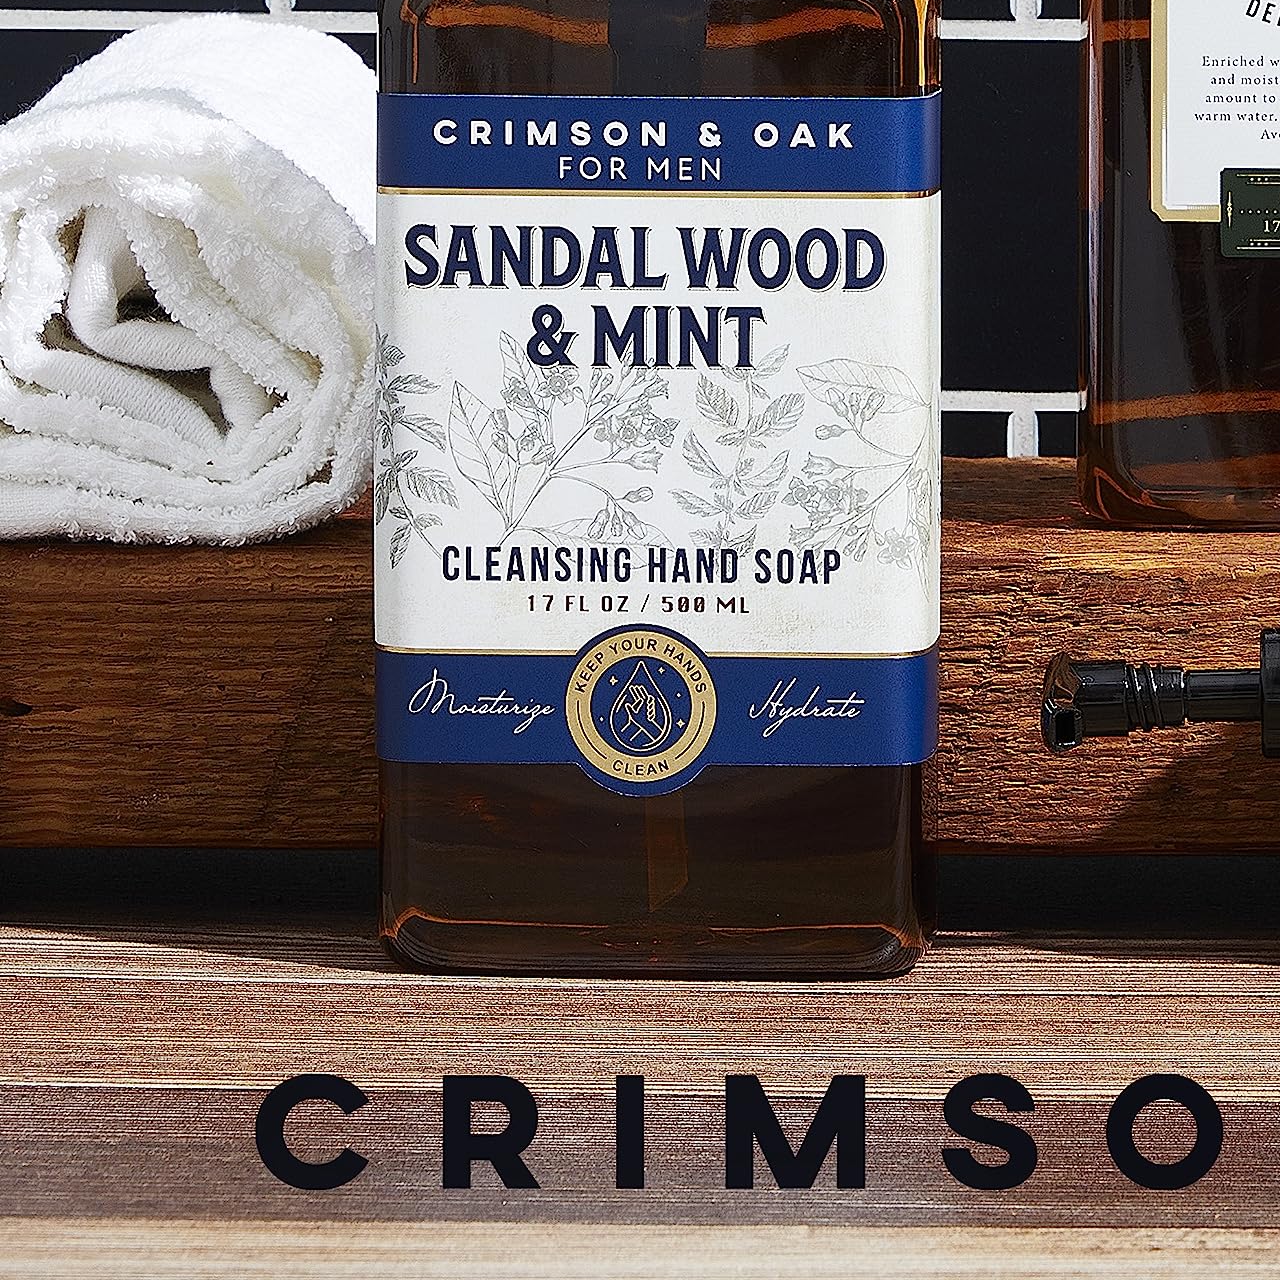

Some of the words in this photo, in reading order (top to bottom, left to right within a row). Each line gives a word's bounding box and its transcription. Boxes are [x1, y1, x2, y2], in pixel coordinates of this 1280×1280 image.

[1202, 56, 1264, 67] Enriched
[1211, 74, 1235, 85] and
[1205, 94, 1257, 103] amount
[1263, 95, 1276, 103] to
[1194, 113, 1230, 121] warm
[1237, 112, 1278, 122] water.
[433, 119, 667, 147] CRIMSON
[699, 121, 723, 147] &
[753, 122, 853, 149] OAK
[559, 157, 627, 180] FOR
[647, 157, 722, 181] MEN
[1264, 221, 1280, 232] 17
[404, 224, 669, 290] SANDAL
[676, 226, 887, 292] WOOD
[526, 304, 580, 368] &
[590, 305, 767, 369] MINT
[442, 546, 632, 582] CLEANSING
[648, 547, 737, 583] HAND
[754, 548, 841, 585] SOAP
[528, 595, 553, 612] 17
[566, 595, 589, 612] FL
[601, 595, 629, 612] OZ
[641, 594, 650, 613] /
[662, 596, 705, 612] 500
[717, 597, 749, 613] ML
[575, 652, 605, 693] KEEP
[609, 638, 658, 655] YOUR
[664, 643, 707, 694] HANDS
[409, 668, 555, 733] Moisturize
[749, 678, 865, 738] Hydrate
[612, 759, 670, 775] CLEAN
